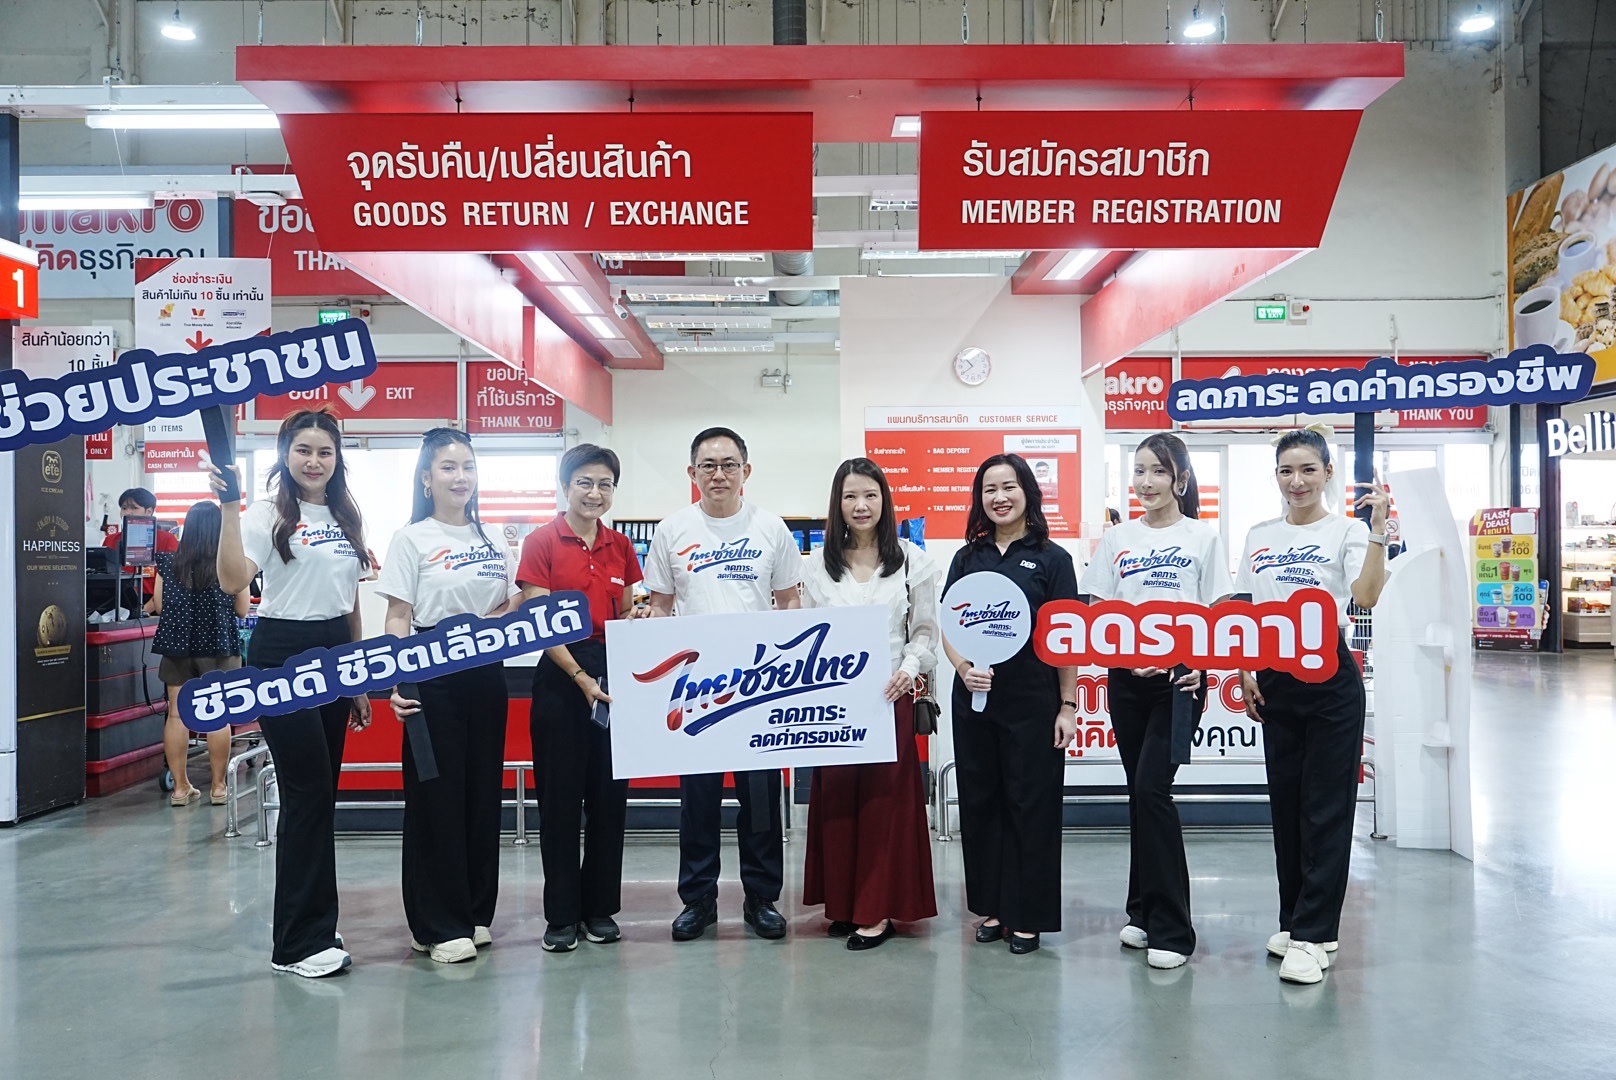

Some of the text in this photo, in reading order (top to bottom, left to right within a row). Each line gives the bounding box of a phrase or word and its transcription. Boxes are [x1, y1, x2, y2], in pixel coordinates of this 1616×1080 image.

[346, 134, 691, 191] จุดรับคืน/เปลี่ยนสินค้า
[962, 139, 1209, 176] รับสมัครสมาชิก
[353, 200, 749, 227] GOODS RETURN / EXCHANGE
[961, 199, 1282, 224] MEMBER REGISTRATION
[172, 272, 233, 284] ช่องชำระเงิน
[12, 269, 24, 308] 1
[142, 287, 264, 301] สินค้าไม่เกิน 10 ชิ้น เท่านั้น
[22, 331, 110, 346] สินค้าน้อยกว่า
[68, 359, 86, 372] 10
[1176, 356, 1583, 411] ลดภาระ ลดค่าครองชีพ
[386, 387, 414, 400] EXIT
[477, 386, 556, 407] ที่ใช้บริการ
[887, 413, 1058, 424] แผนกบริการสมาชิก CUSTOMER SERVICE
[1402, 408, 1474, 421] THANK YOU
[480, 416, 553, 428] THANK YOU
[147, 446, 195, 458] เงินสดเท่านั้น
[932, 485, 950, 493] GOODS
[950, 485, 970, 493] RETURN
[1483, 510, 1510, 521] FLASH
[1485, 519, 1509, 528] DEALS
[23, 540, 80, 552] HAPPINESS
[1511, 547, 1530, 555] 100
[677, 537, 762, 572] ไทยช่วยไทย
[724, 563, 754, 571] ลดภาระ
[1020, 560, 1037, 570] DBD
[1283, 566, 1315, 576] ลดภาระ
[1275, 575, 1321, 586] ลดค่าครองชีพ
[1514, 593, 1533, 601] 100
[951, 600, 1021, 626] ไทยช่วยไทย
[988, 622, 1012, 630] ลดภาระ
[1046, 602, 1323, 669] ลดราคา!
[191, 599, 583, 722] ชีวิตดี ชีวิตเลือกได้
[632, 622, 869, 733] ไทยช่วยไทย
[768, 704, 846, 726] ลดภาระ
[749, 725, 868, 749] ลดค่าครองชีพ
